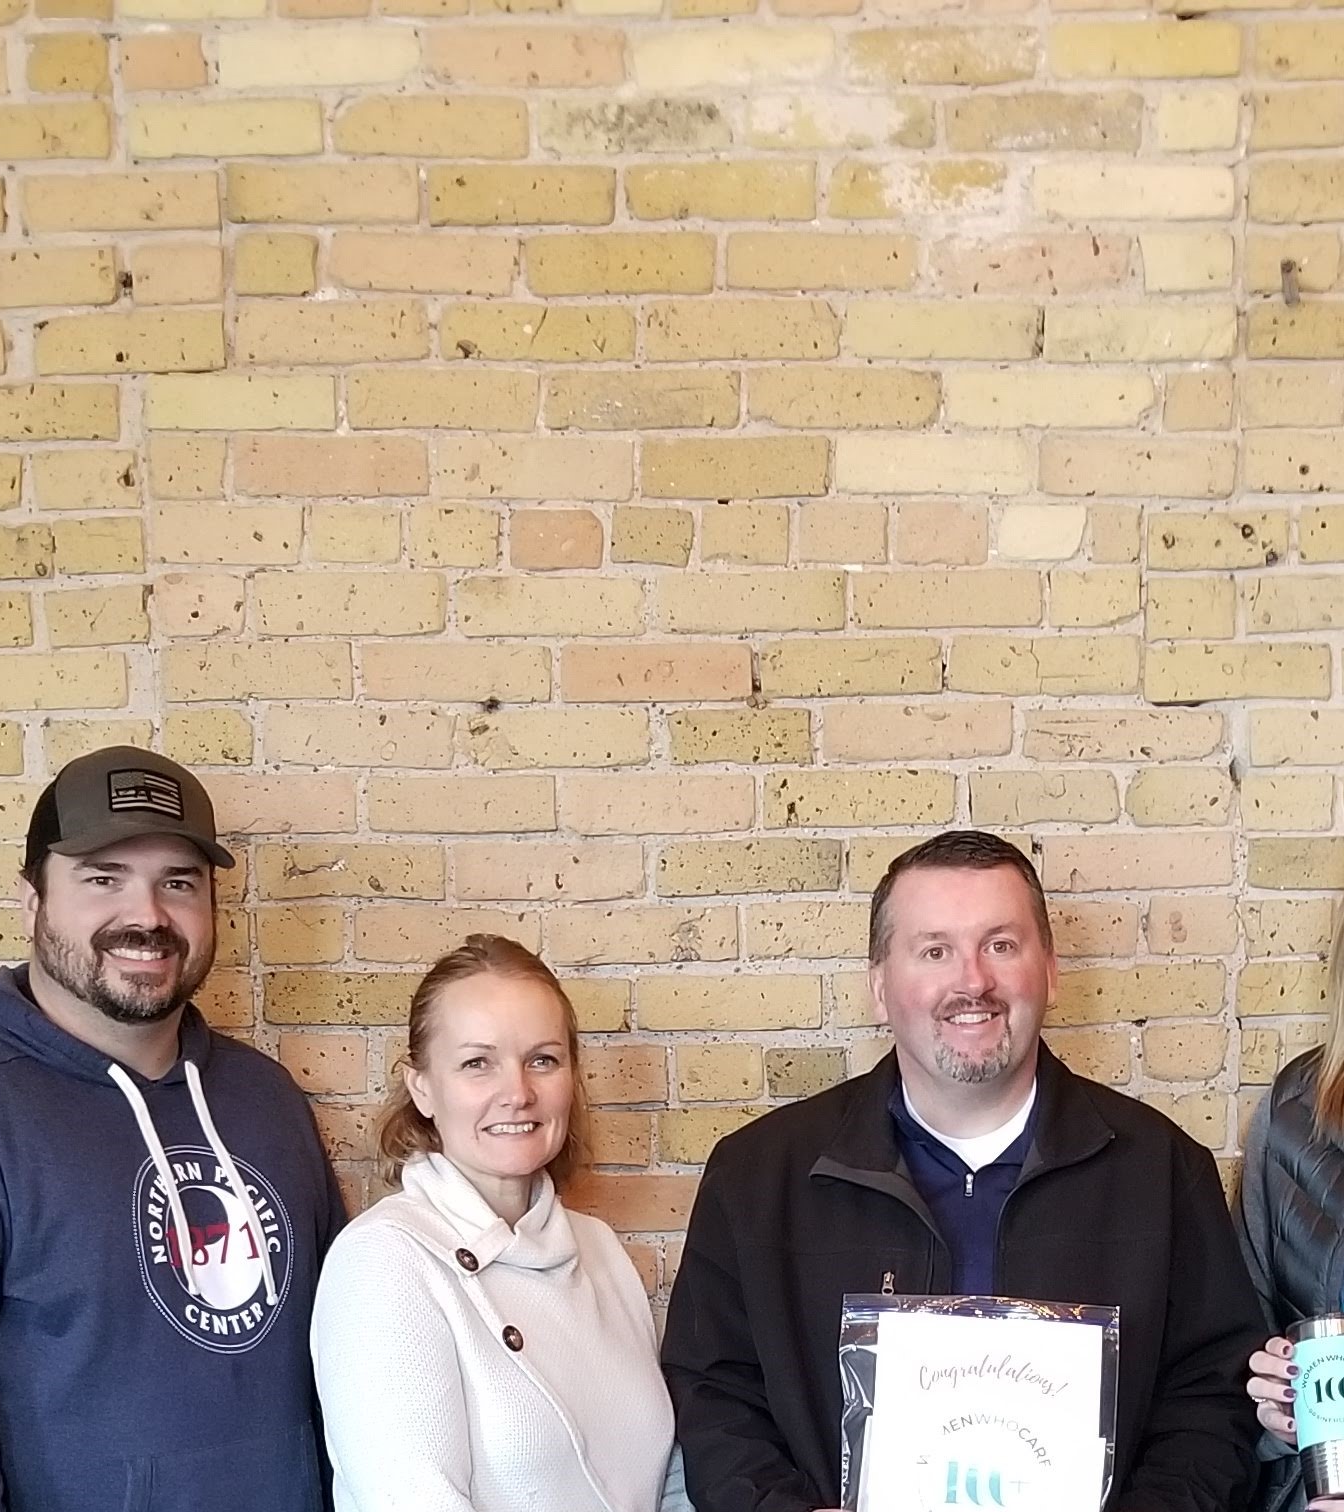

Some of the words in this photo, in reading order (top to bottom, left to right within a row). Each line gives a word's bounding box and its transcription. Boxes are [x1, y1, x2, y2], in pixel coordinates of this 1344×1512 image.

[147, 1161, 203, 1264] NORTHRN
[214, 1165, 281, 1253] PCIFIC
[166, 1221, 260, 1268] 1871
[185, 1302, 264, 1336] CENTER
[919, 1353, 1069, 1398] Congratulations!
[1301, 1357, 1324, 1389] WOMEN
[974, 1413, 1019, 1432] WHO
